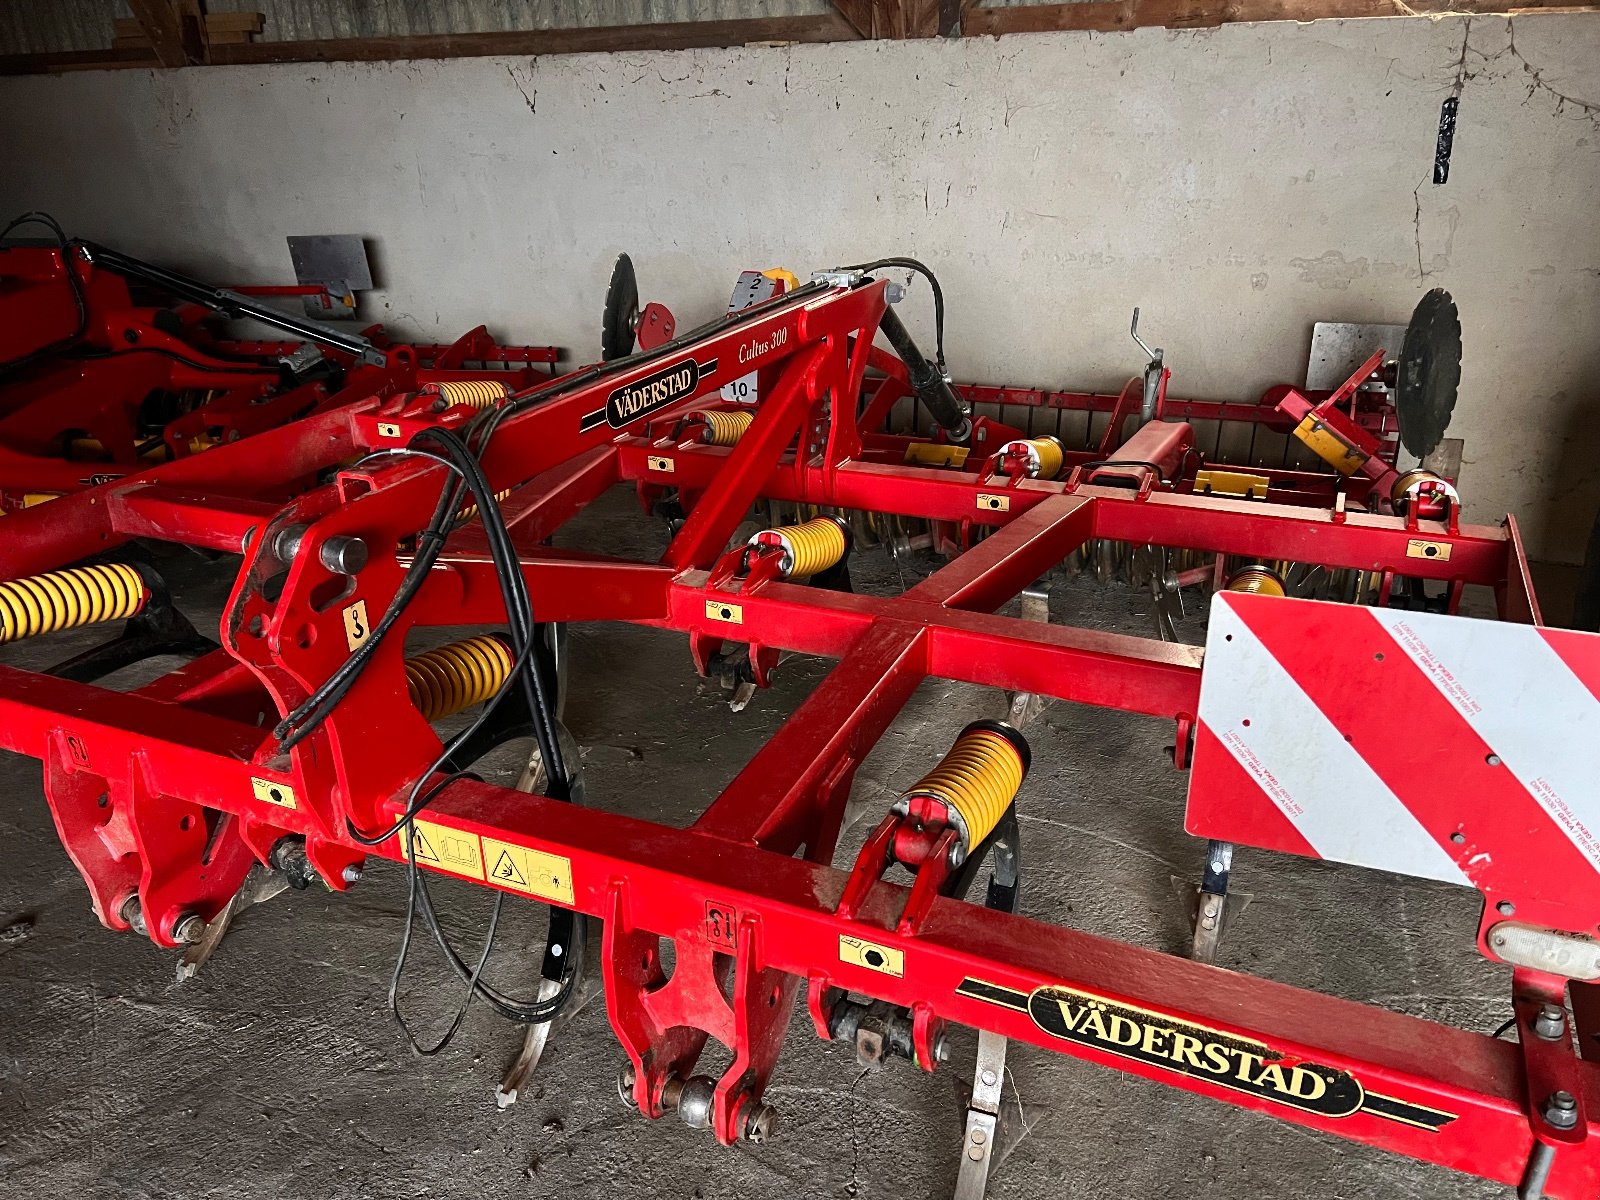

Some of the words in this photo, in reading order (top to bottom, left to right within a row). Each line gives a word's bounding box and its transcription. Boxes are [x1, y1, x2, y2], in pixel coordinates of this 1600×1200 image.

[750, 278, 761, 289] 2
[739, 340, 768, 363] Cultus
[771, 327, 787, 349] 300
[614, 369, 691, 418] VÄDERSTAD
[731, 382, 747, 396] 10
[1420, 655, 1436, 673] GEKA
[1437, 663, 1454, 681] GEKA
[1248, 761, 1262, 778] GEKA
[1264, 769, 1279, 786] GEKA
[1558, 812, 1575, 830] GEKA
[1576, 821, 1592, 839] GEKA
[1056, 1000, 1327, 1100] VÄDERSTAD
